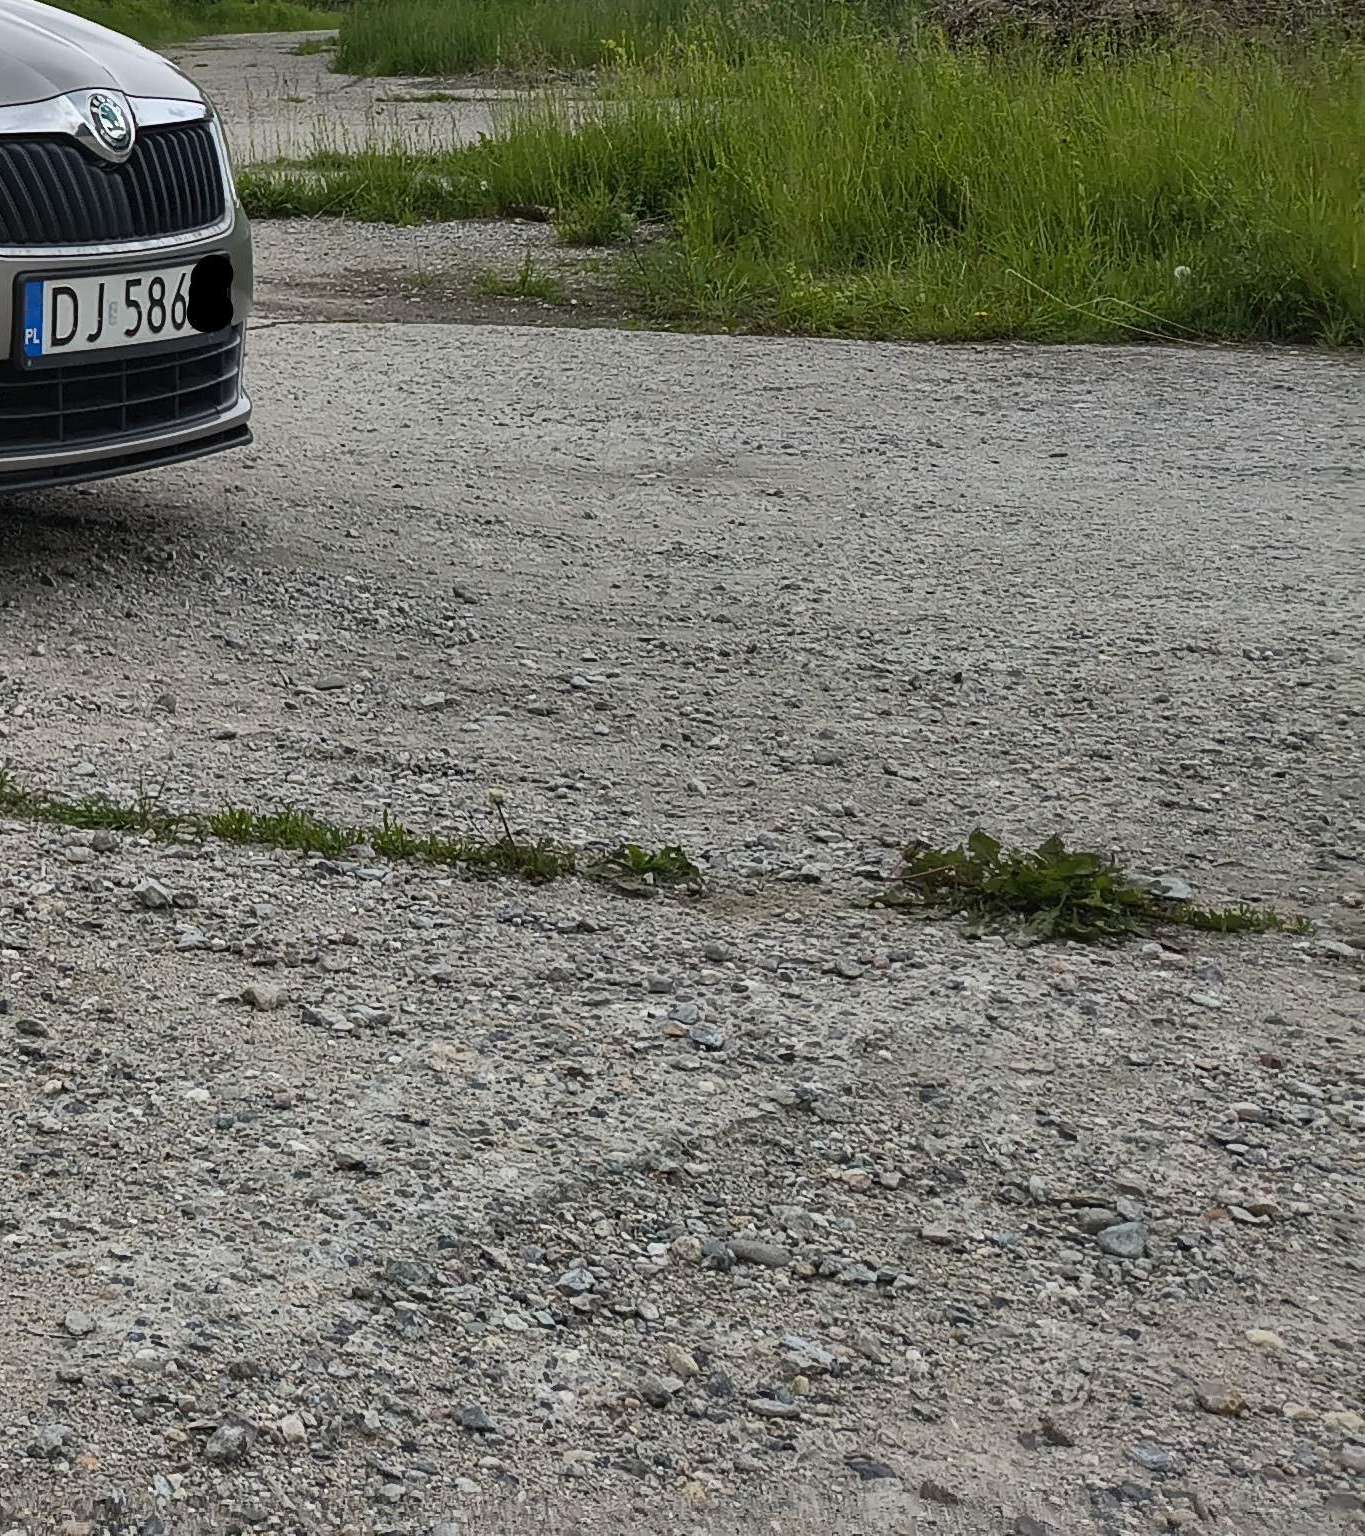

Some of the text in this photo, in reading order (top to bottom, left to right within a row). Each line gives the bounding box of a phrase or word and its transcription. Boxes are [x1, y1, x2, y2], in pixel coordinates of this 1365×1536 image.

[50, 272, 188, 347] DJ 586
[25, 328, 40, 345] PL
